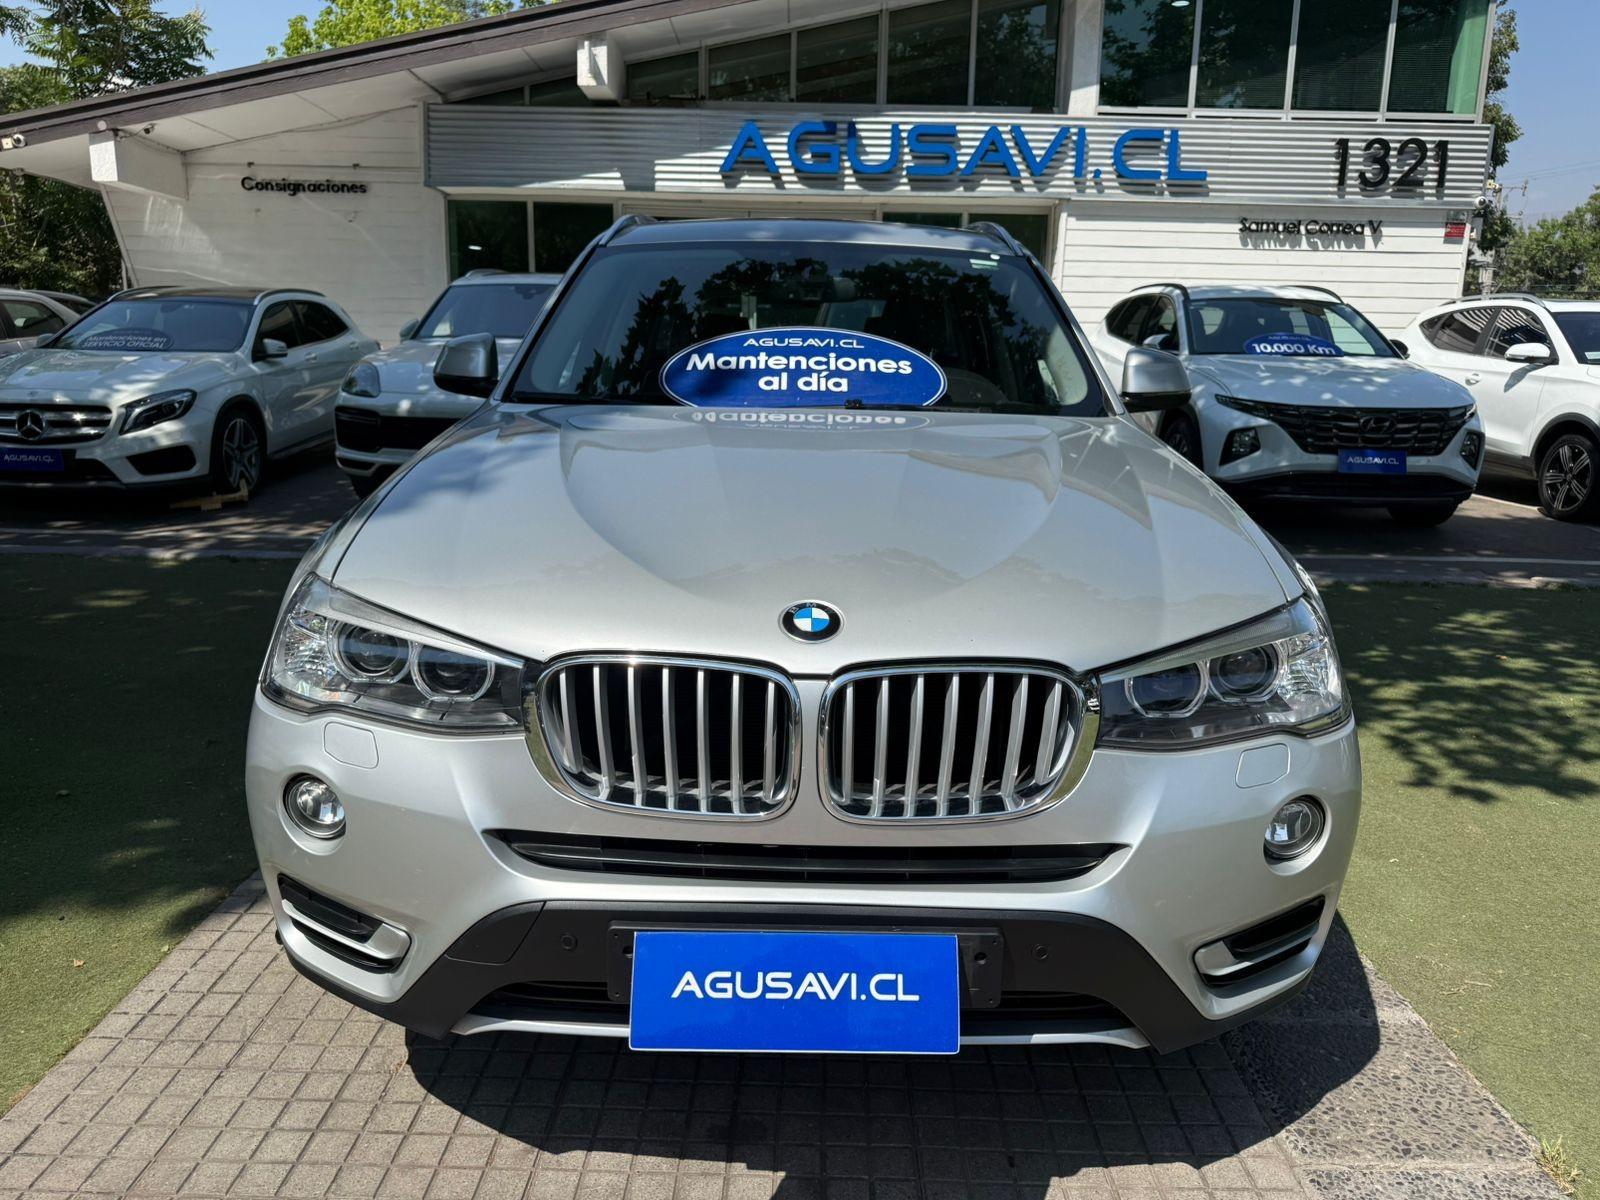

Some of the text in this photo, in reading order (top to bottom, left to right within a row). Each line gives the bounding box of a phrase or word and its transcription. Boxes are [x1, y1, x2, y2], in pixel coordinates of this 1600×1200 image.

[720, 120, 1208, 184] AGUSAVI.CL
[1334, 137, 1449, 188] 1321
[241, 176, 367, 196] Consignaciones
[1239, 217, 1301, 234] Samuel
[1304, 219, 1365, 235] Correa
[743, 338, 865, 348] AGUSAVI.CL
[1252, 342, 1337, 355] 10.000 Km
[686, 352, 913, 374] Mantenciones
[758, 372, 848, 392] al día
[1347, 456, 1400, 464] AGUSAVI.CL
[671, 970, 920, 1001] AGUSAVI.CL
